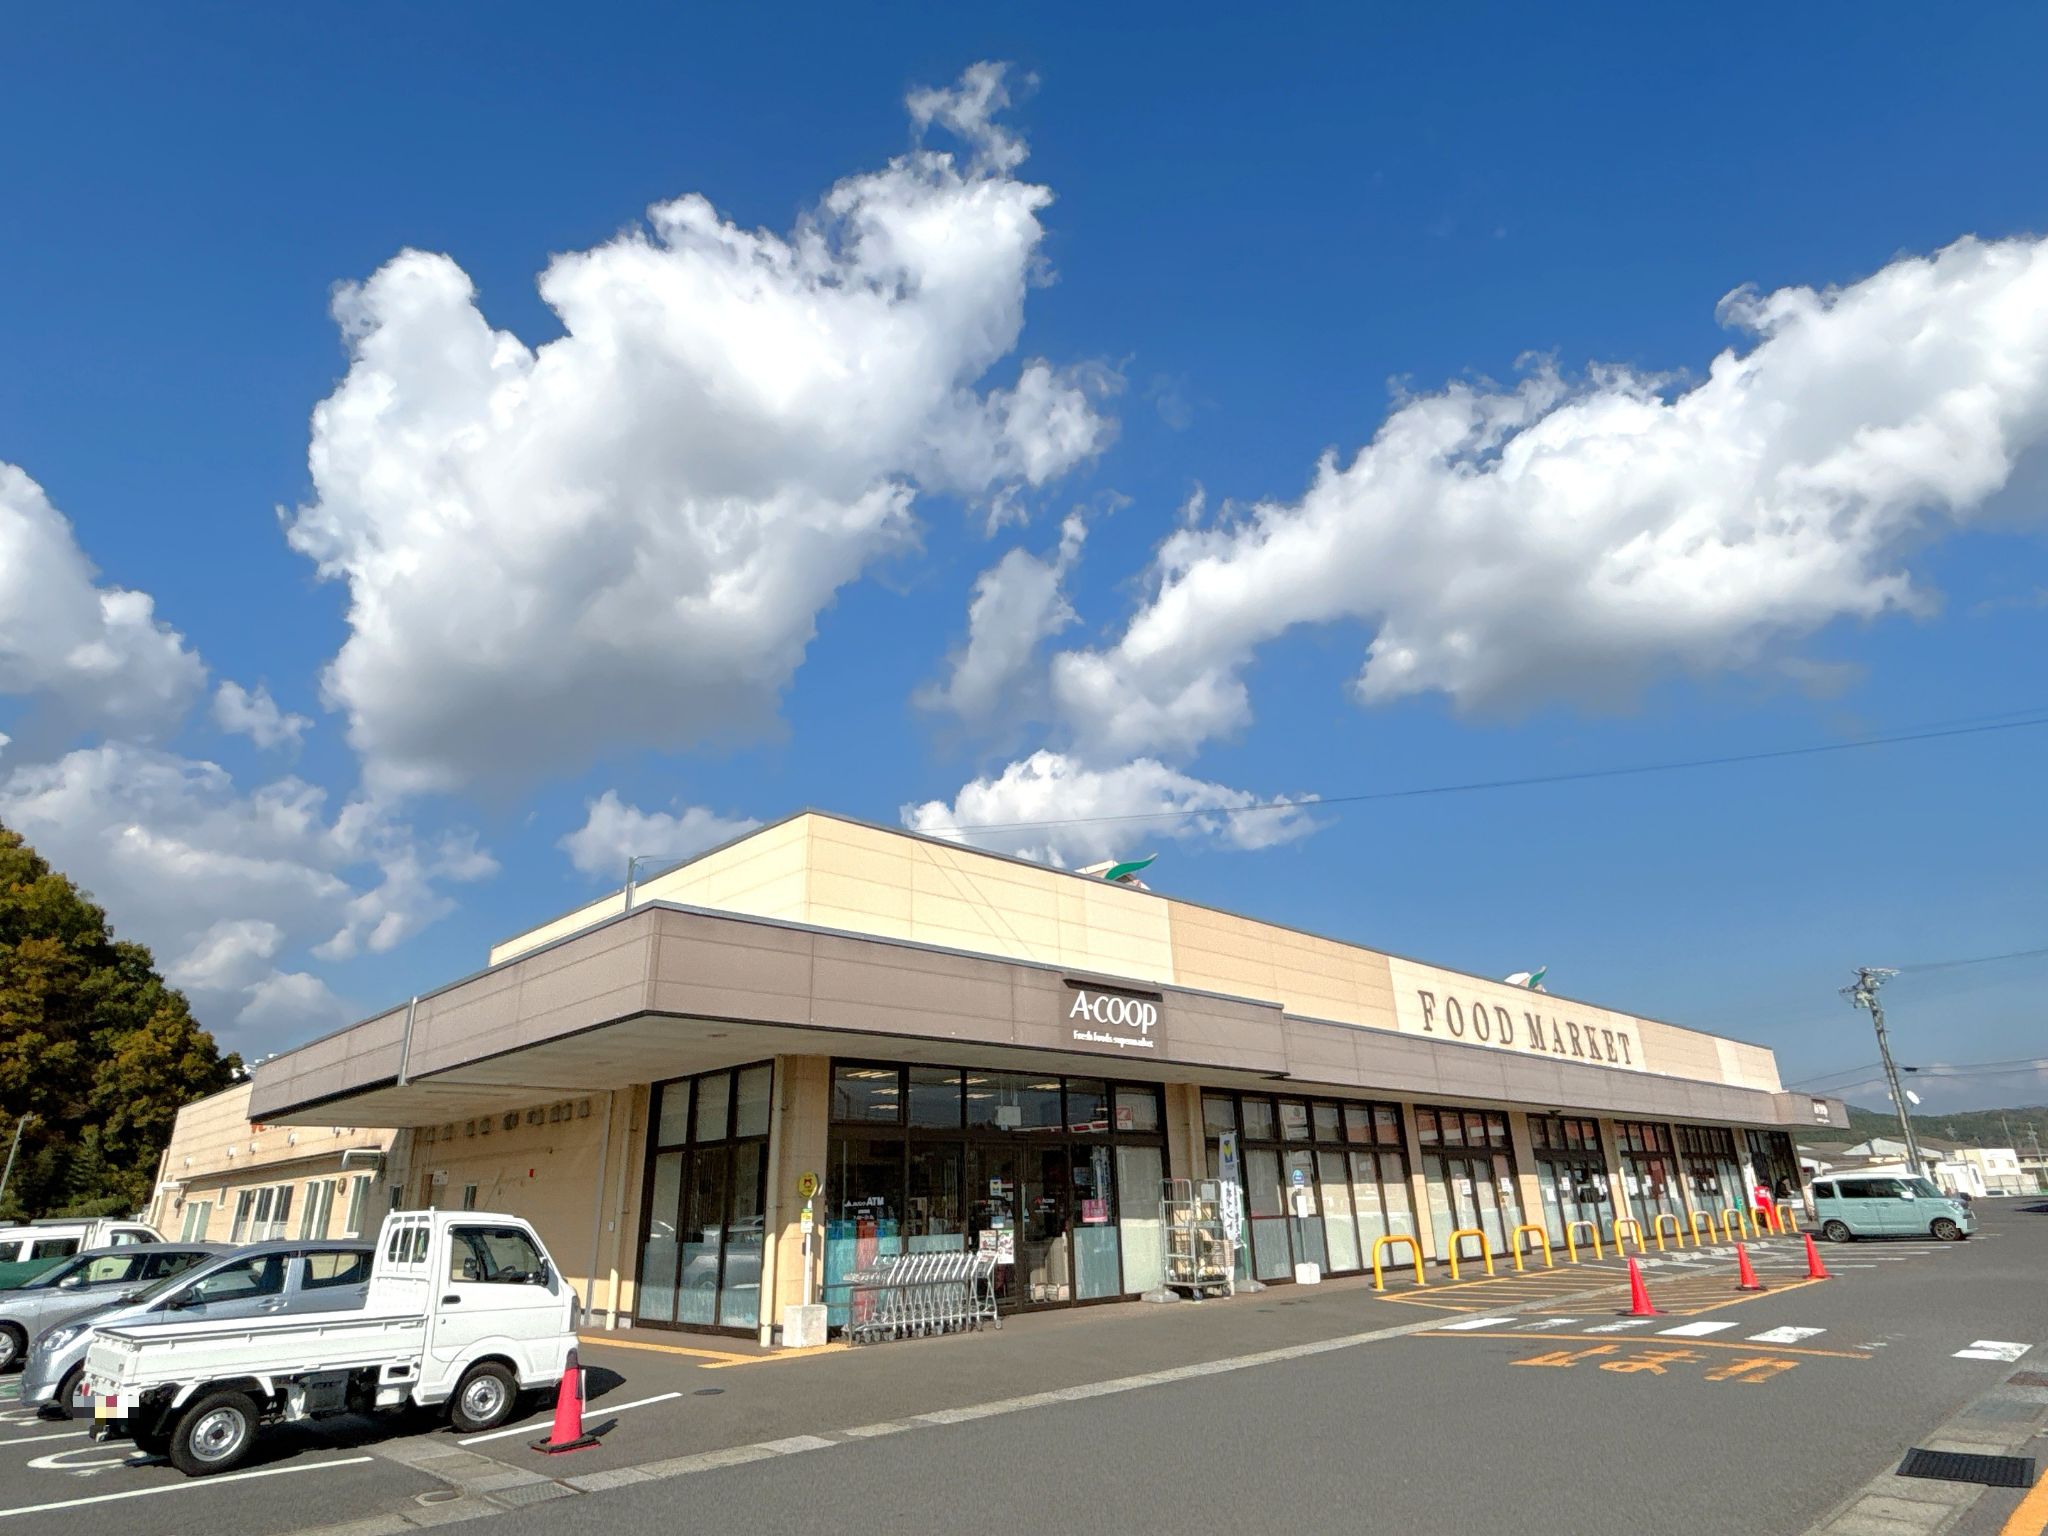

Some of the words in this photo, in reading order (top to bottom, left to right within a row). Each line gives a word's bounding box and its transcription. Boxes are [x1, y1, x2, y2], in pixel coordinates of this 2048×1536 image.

[1417, 989, 1514, 1045] FOOD
[1523, 1011, 1632, 1065] MARKET
[866, 1196, 885, 1207] ATM
